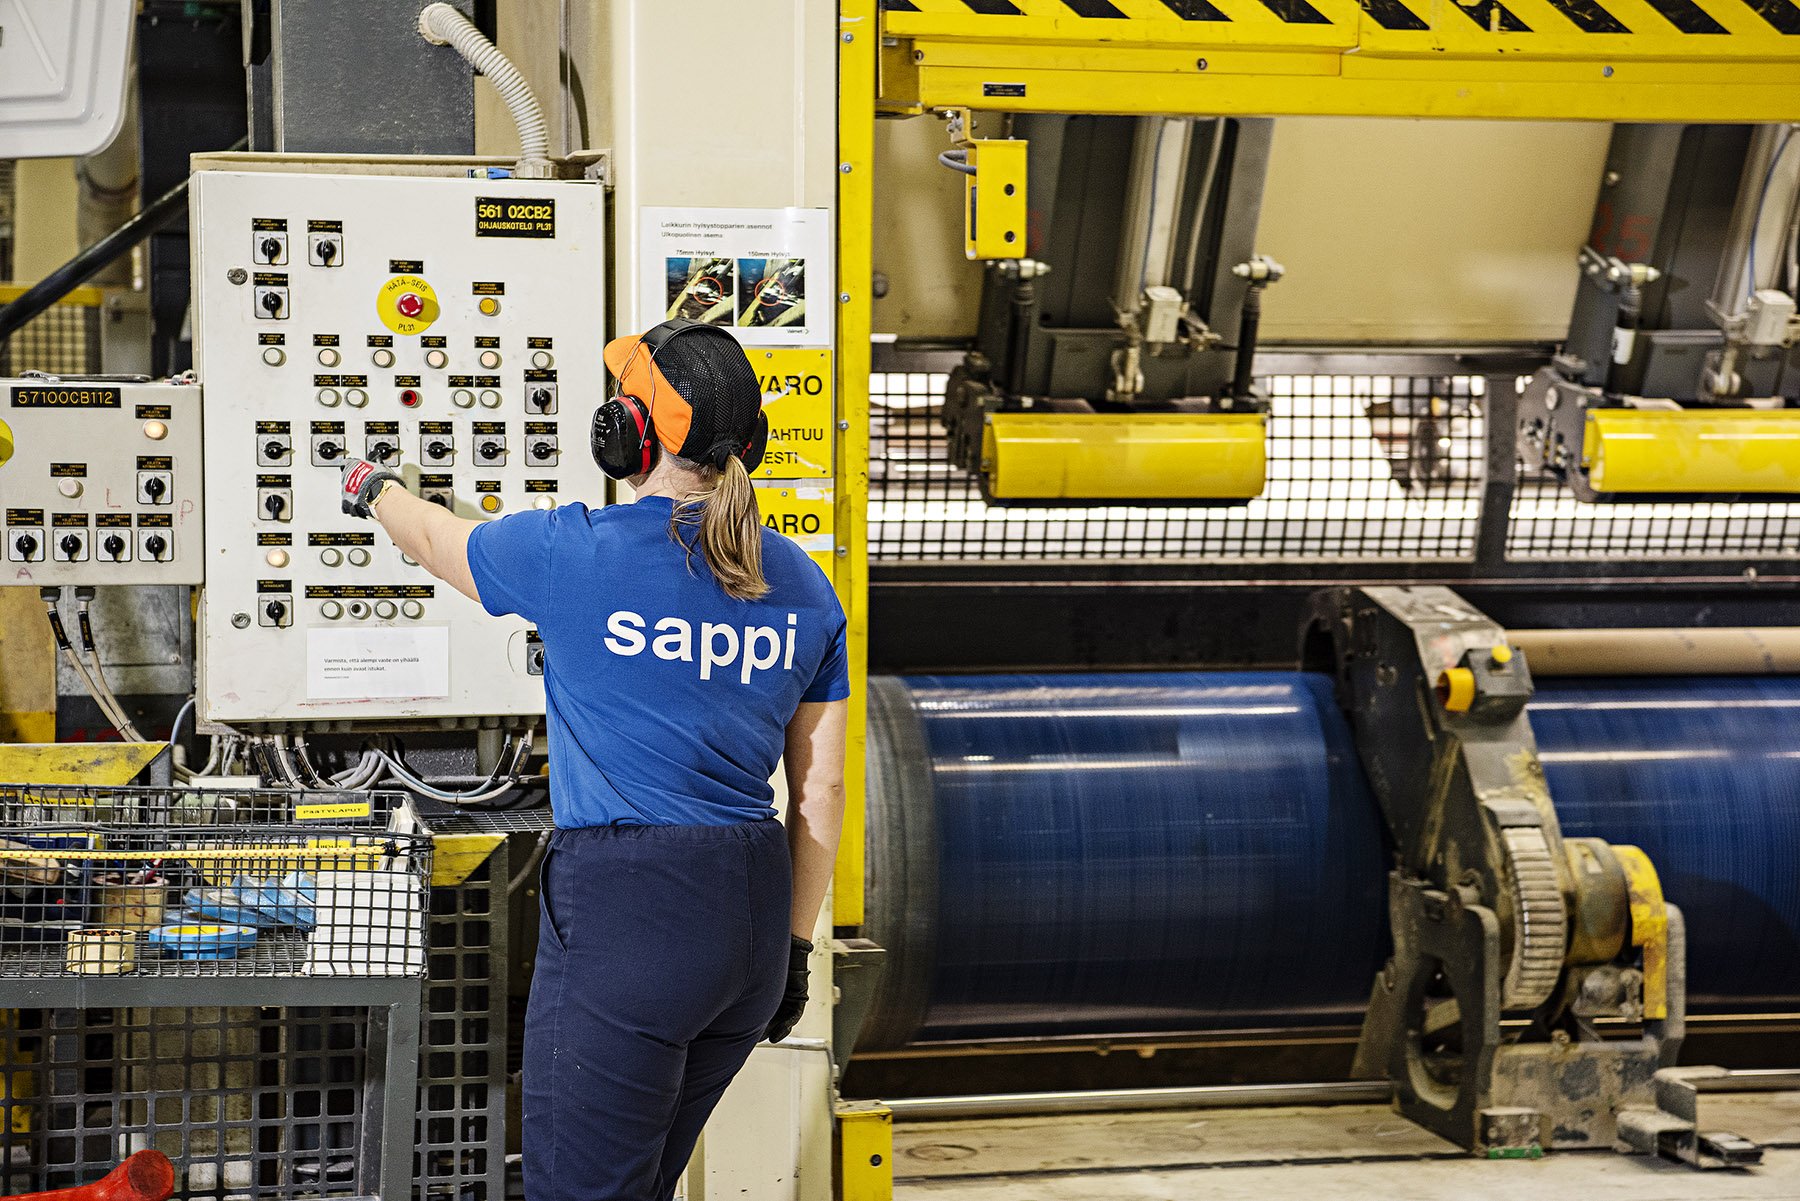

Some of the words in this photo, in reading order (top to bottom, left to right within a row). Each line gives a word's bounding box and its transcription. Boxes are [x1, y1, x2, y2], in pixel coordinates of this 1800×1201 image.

[478, 204, 503, 218] 561
[478, 221, 533, 230] OHJAUSKOTELO
[603, 610, 798, 685] sappi
